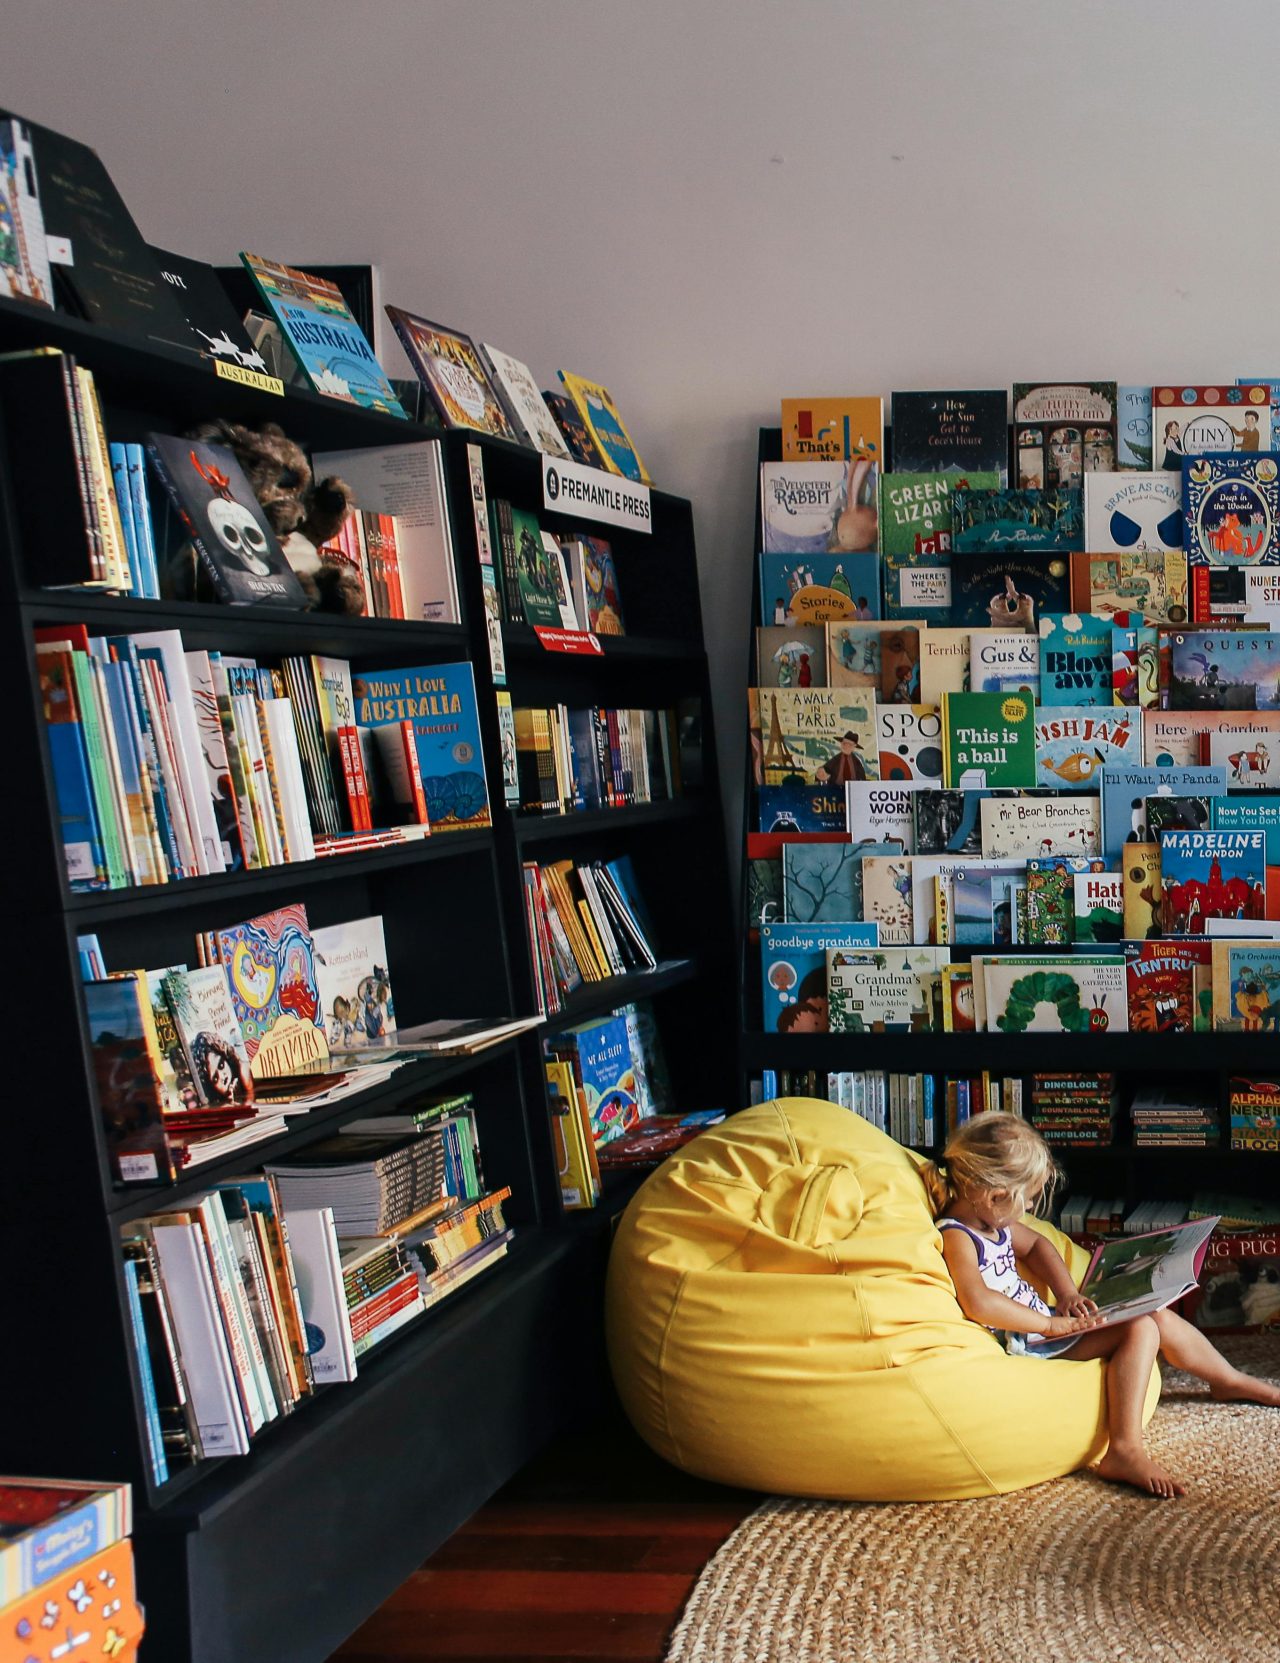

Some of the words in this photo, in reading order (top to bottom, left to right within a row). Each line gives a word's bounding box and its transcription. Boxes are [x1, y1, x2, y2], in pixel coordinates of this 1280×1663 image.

[287, 321, 374, 362] AUSTRALIA
[220, 365, 281, 391] AUSTRALIAN
[1189, 428, 1228, 442] TINY
[797, 440, 840, 453] That's
[562, 477, 621, 510] FREMANTLE
[623, 494, 650, 519] PRESS
[890, 479, 949, 506] GREEN
[1104, 486, 1136, 512] BRAVE
[1134, 482, 1153, 493] AS
[774, 489, 831, 515] RABBIT
[1214, 502, 1226, 510] the
[1228, 501, 1253, 510] Woods
[272, 583, 286, 593] TAN
[800, 596, 845, 610] Stories
[815, 611, 830, 620] for
[925, 643, 969, 656] Terrible
[1204, 640, 1274, 650] QUEST
[981, 646, 1014, 663] Gus
[1019, 646, 1036, 663] &
[368, 681, 400, 698] WHY
[405, 679, 411, 695] I
[415, 677, 447, 694] LOVE
[794, 695, 802, 705] A
[803, 693, 834, 705] WALK
[361, 694, 461, 722] AUSTRALIA
[797, 713, 836, 728] PARIS
[1154, 723, 1187, 735] Here
[957, 729, 998, 744] This
[1002, 729, 1018, 744] is
[958, 752, 968, 764] a
[972, 748, 1007, 764] ball
[1160, 774, 1178, 784] Mr
[1182, 773, 1221, 785] Panda
[1000, 810, 1012, 821] Mr
[1018, 807, 1040, 819] Bear
[1045, 804, 1091, 818] Branches
[1219, 807, 1237, 816] Now
[1240, 807, 1256, 816] You
[1258, 807, 1276, 816] See
[1219, 816, 1237, 824] Now
[1240, 816, 1256, 824] You
[1162, 833, 1263, 849] MADELINE
[1181, 849, 1192, 857] IN
[1200, 849, 1243, 858] LONDON
[1087, 899, 1105, 908] and
[1107, 899, 1122, 908] the
[768, 936, 814, 949] goodbye
[818, 936, 871, 949] grandma
[1232, 953, 1248, 961] The
[855, 974, 921, 985] Grandma's
[869, 985, 908, 997] House
[259, 1029, 321, 1078] DREAMERS
[1044, 1081, 1098, 1089] DINOBLOCK
[1241, 1240, 1277, 1255] PUG
